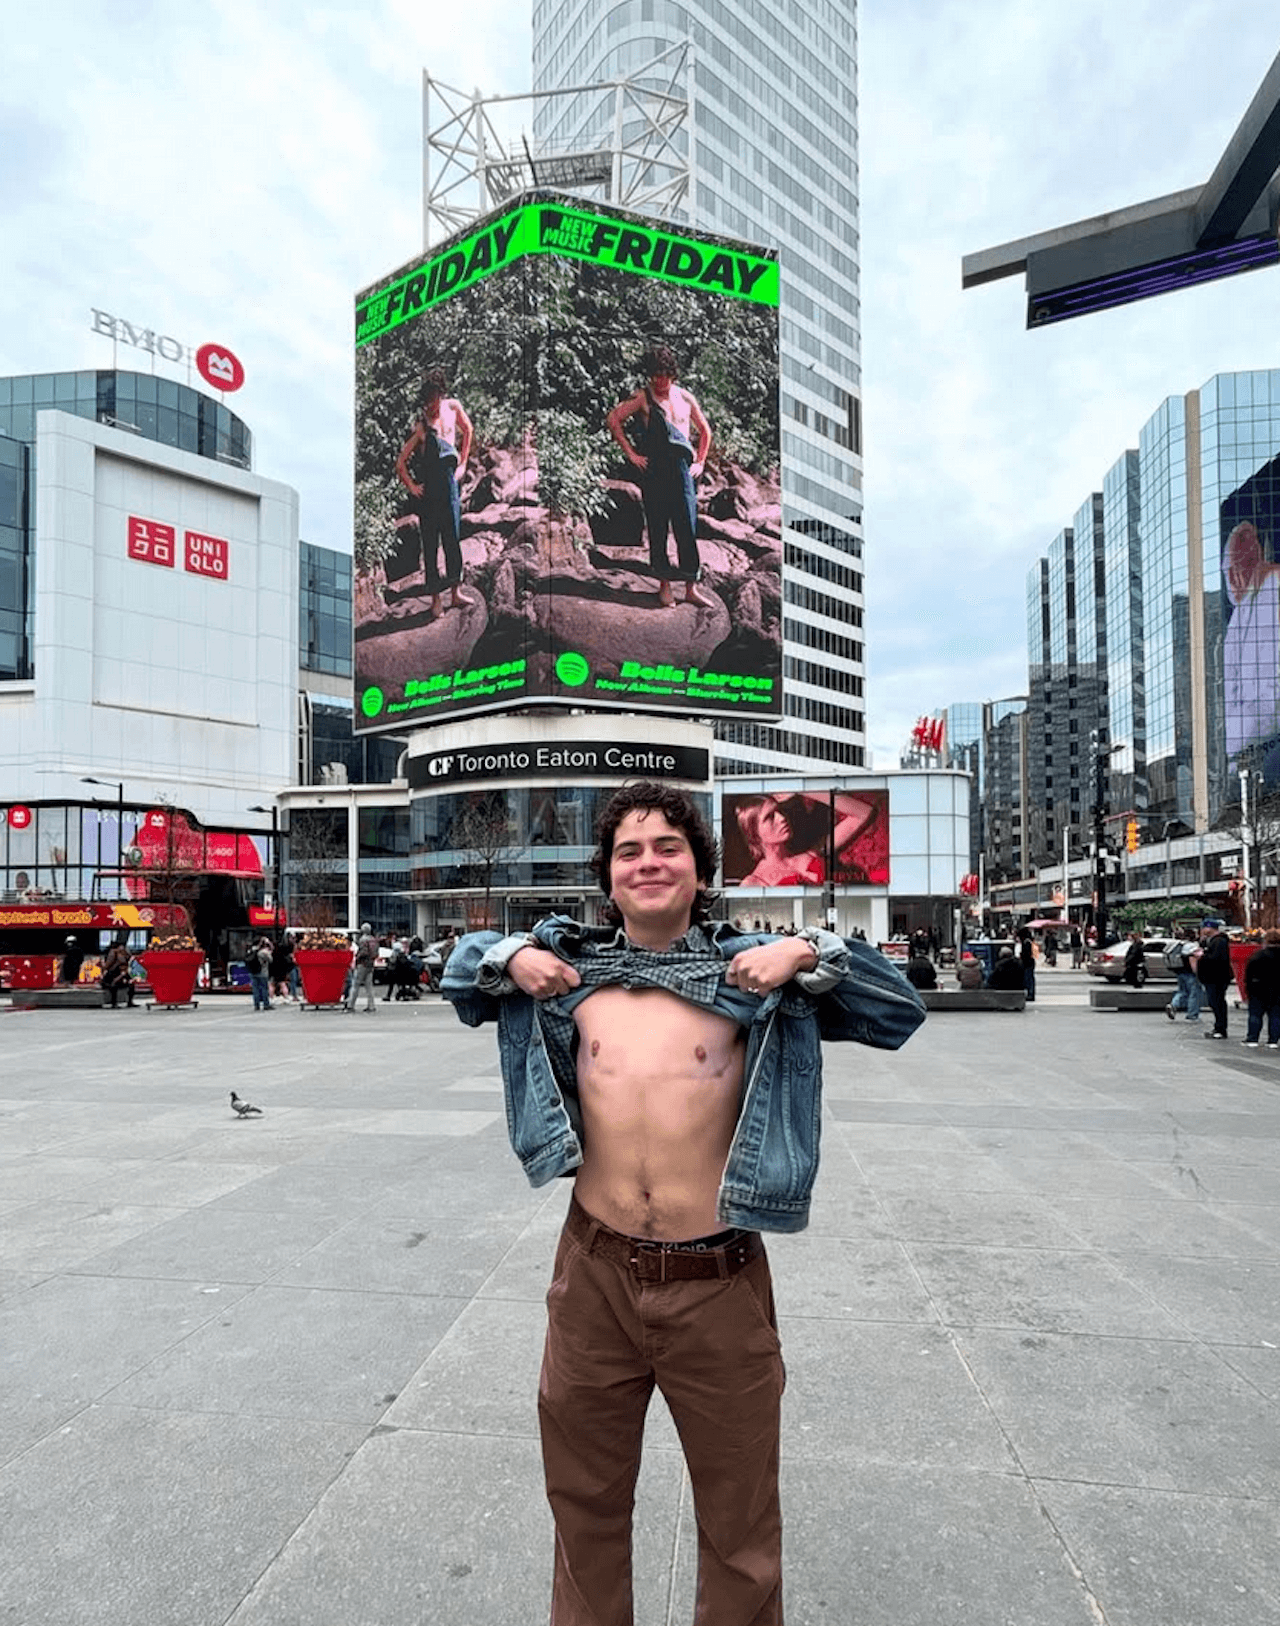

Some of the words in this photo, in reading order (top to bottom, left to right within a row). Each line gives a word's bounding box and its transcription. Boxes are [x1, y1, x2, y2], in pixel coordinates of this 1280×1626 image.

[542, 228, 594, 253] MUSIC
[561, 215, 598, 234] NEW
[385, 214, 522, 325] FRIDAY
[591, 223, 769, 295] FRIDAY
[91, 307, 183, 362] BMO
[404, 674, 452, 698] Bells
[452, 658, 526, 687] Larsen
[620, 661, 685, 683] Bells
[687, 667, 773, 690] Larsen
[428, 755, 454, 777] CF
[456, 753, 530, 773] Toronto
[536, 748, 597, 768] Eaton
[604, 748, 676, 770] Centre
